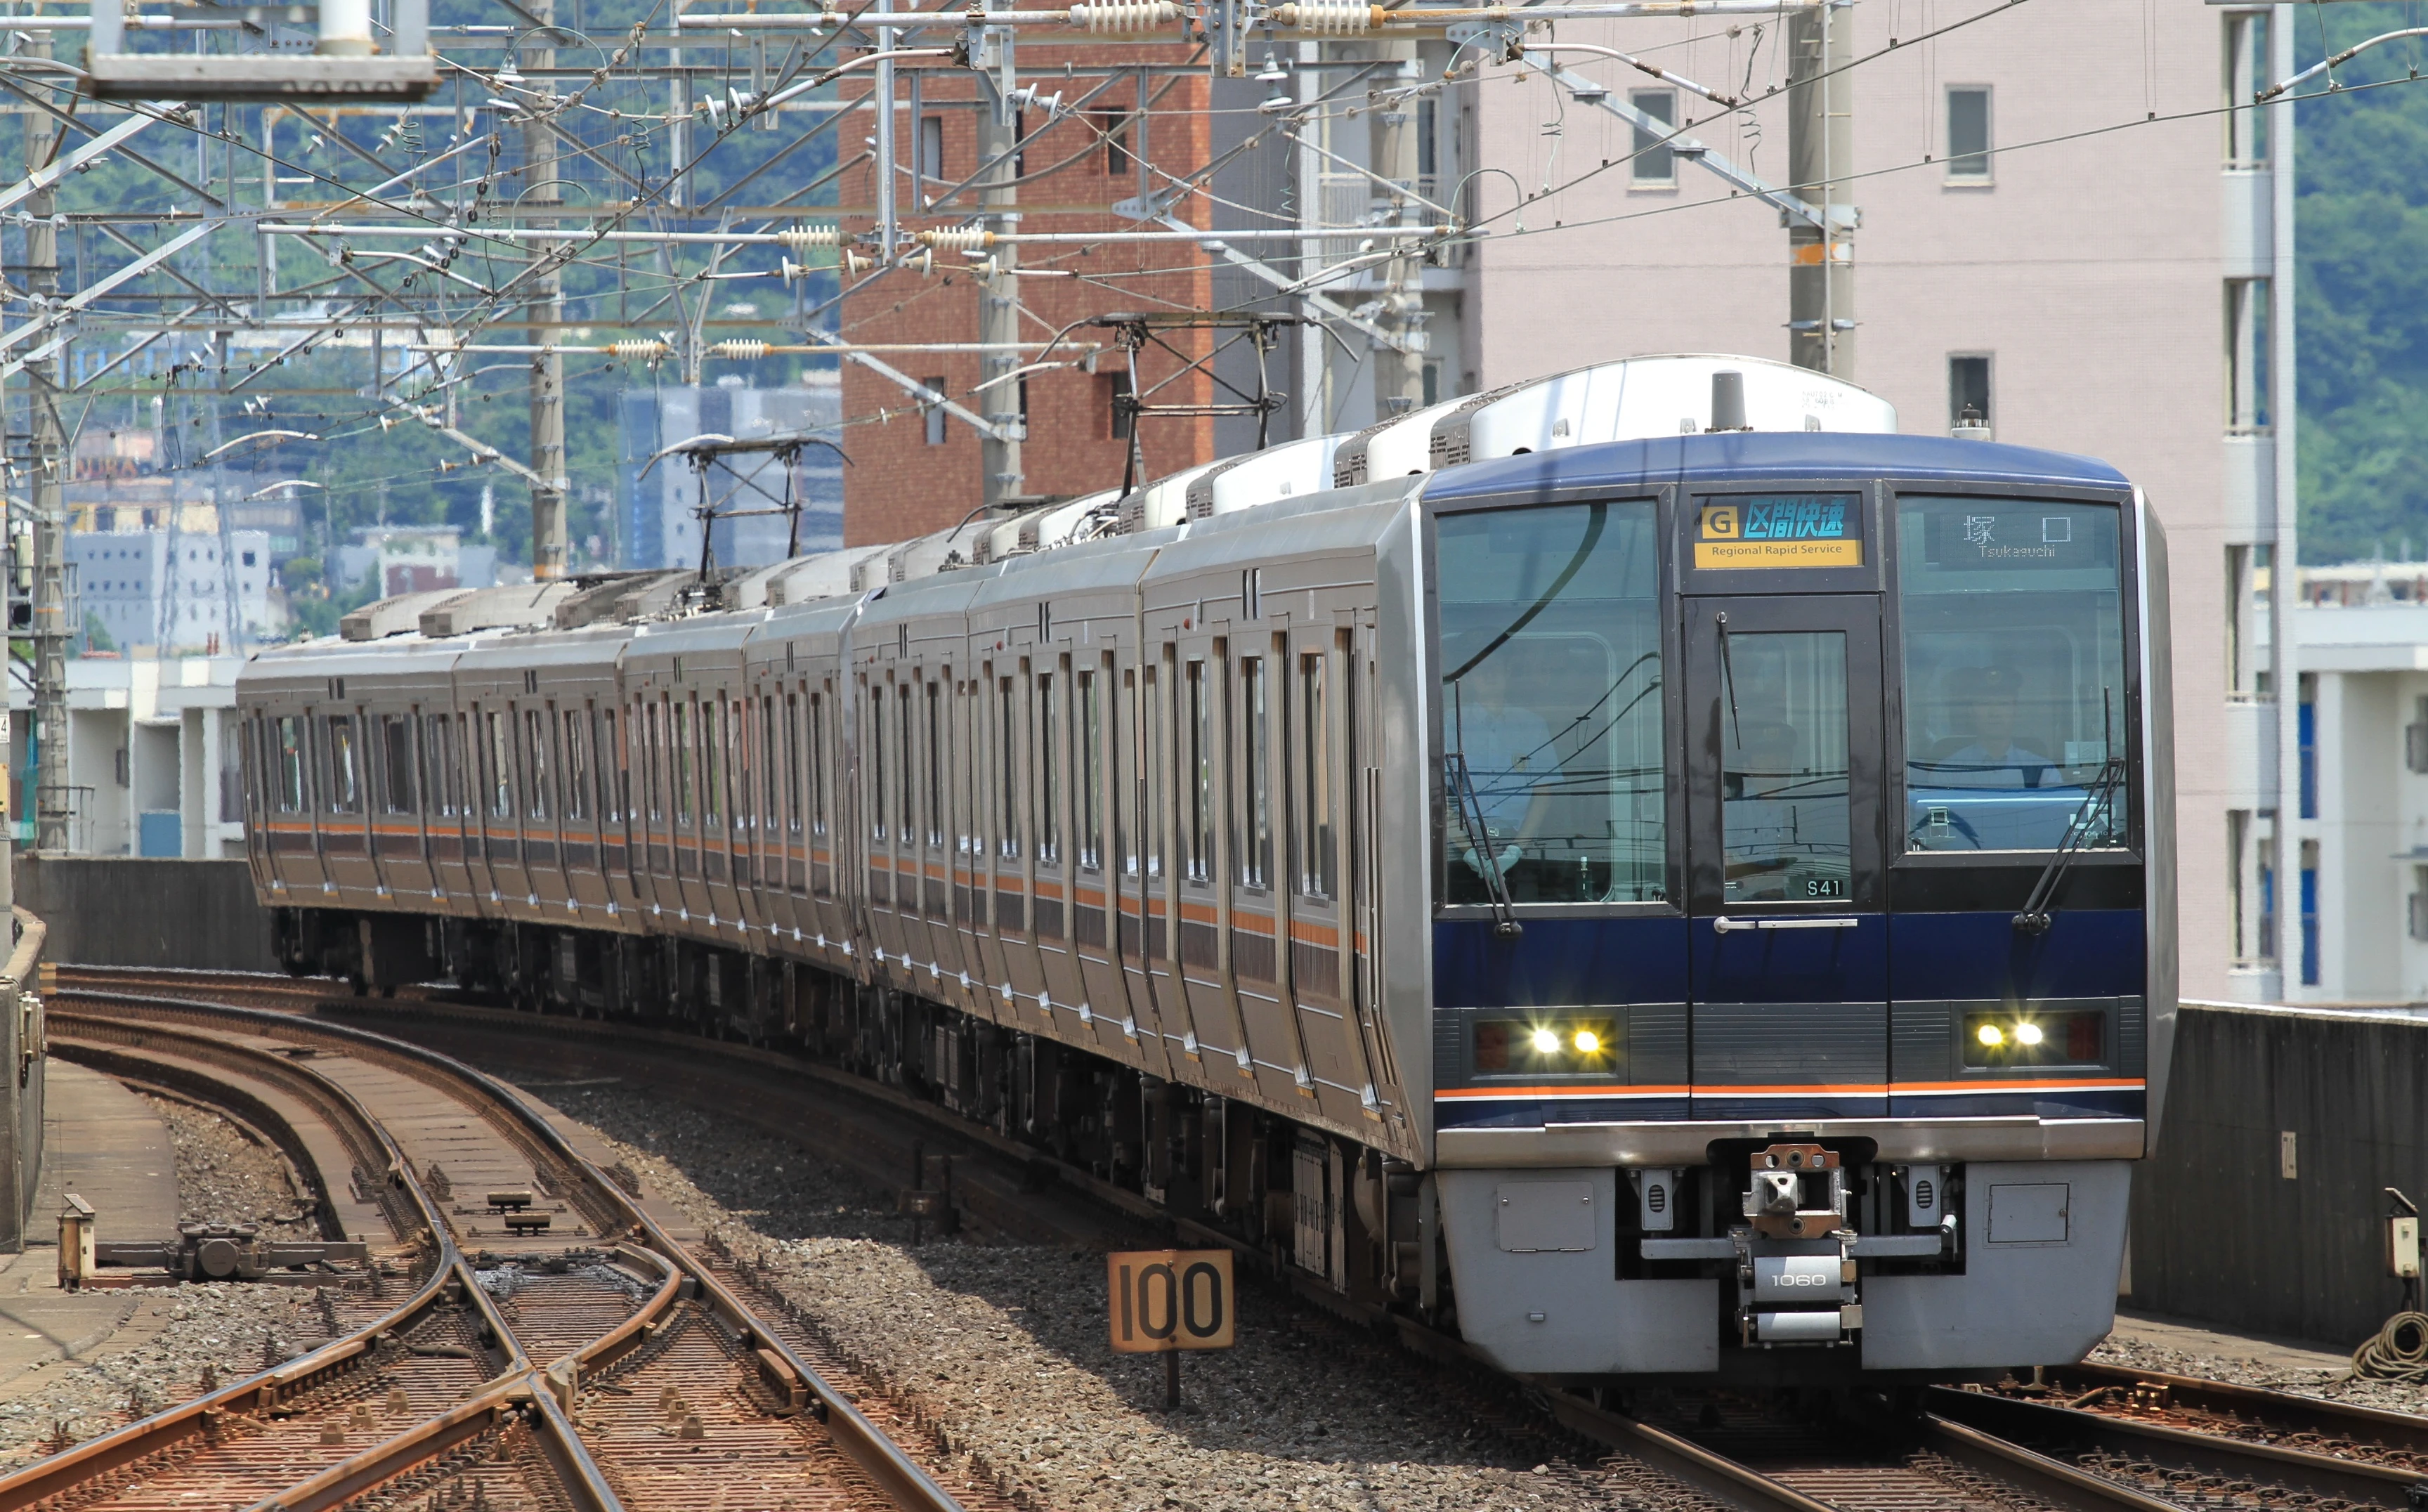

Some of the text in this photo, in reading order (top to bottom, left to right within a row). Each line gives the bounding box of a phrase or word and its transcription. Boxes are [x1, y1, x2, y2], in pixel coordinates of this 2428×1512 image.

[1709, 511, 1730, 533] G
[1744, 497, 1848, 538] 区間快速
[1711, 544, 1842, 557] Regional Rapid Service
[2070, 804, 2116, 829] JR
[1808, 880, 1839, 896] S41
[1772, 1275, 1826, 1286] 1060
[1119, 1262, 1222, 1341] 100
